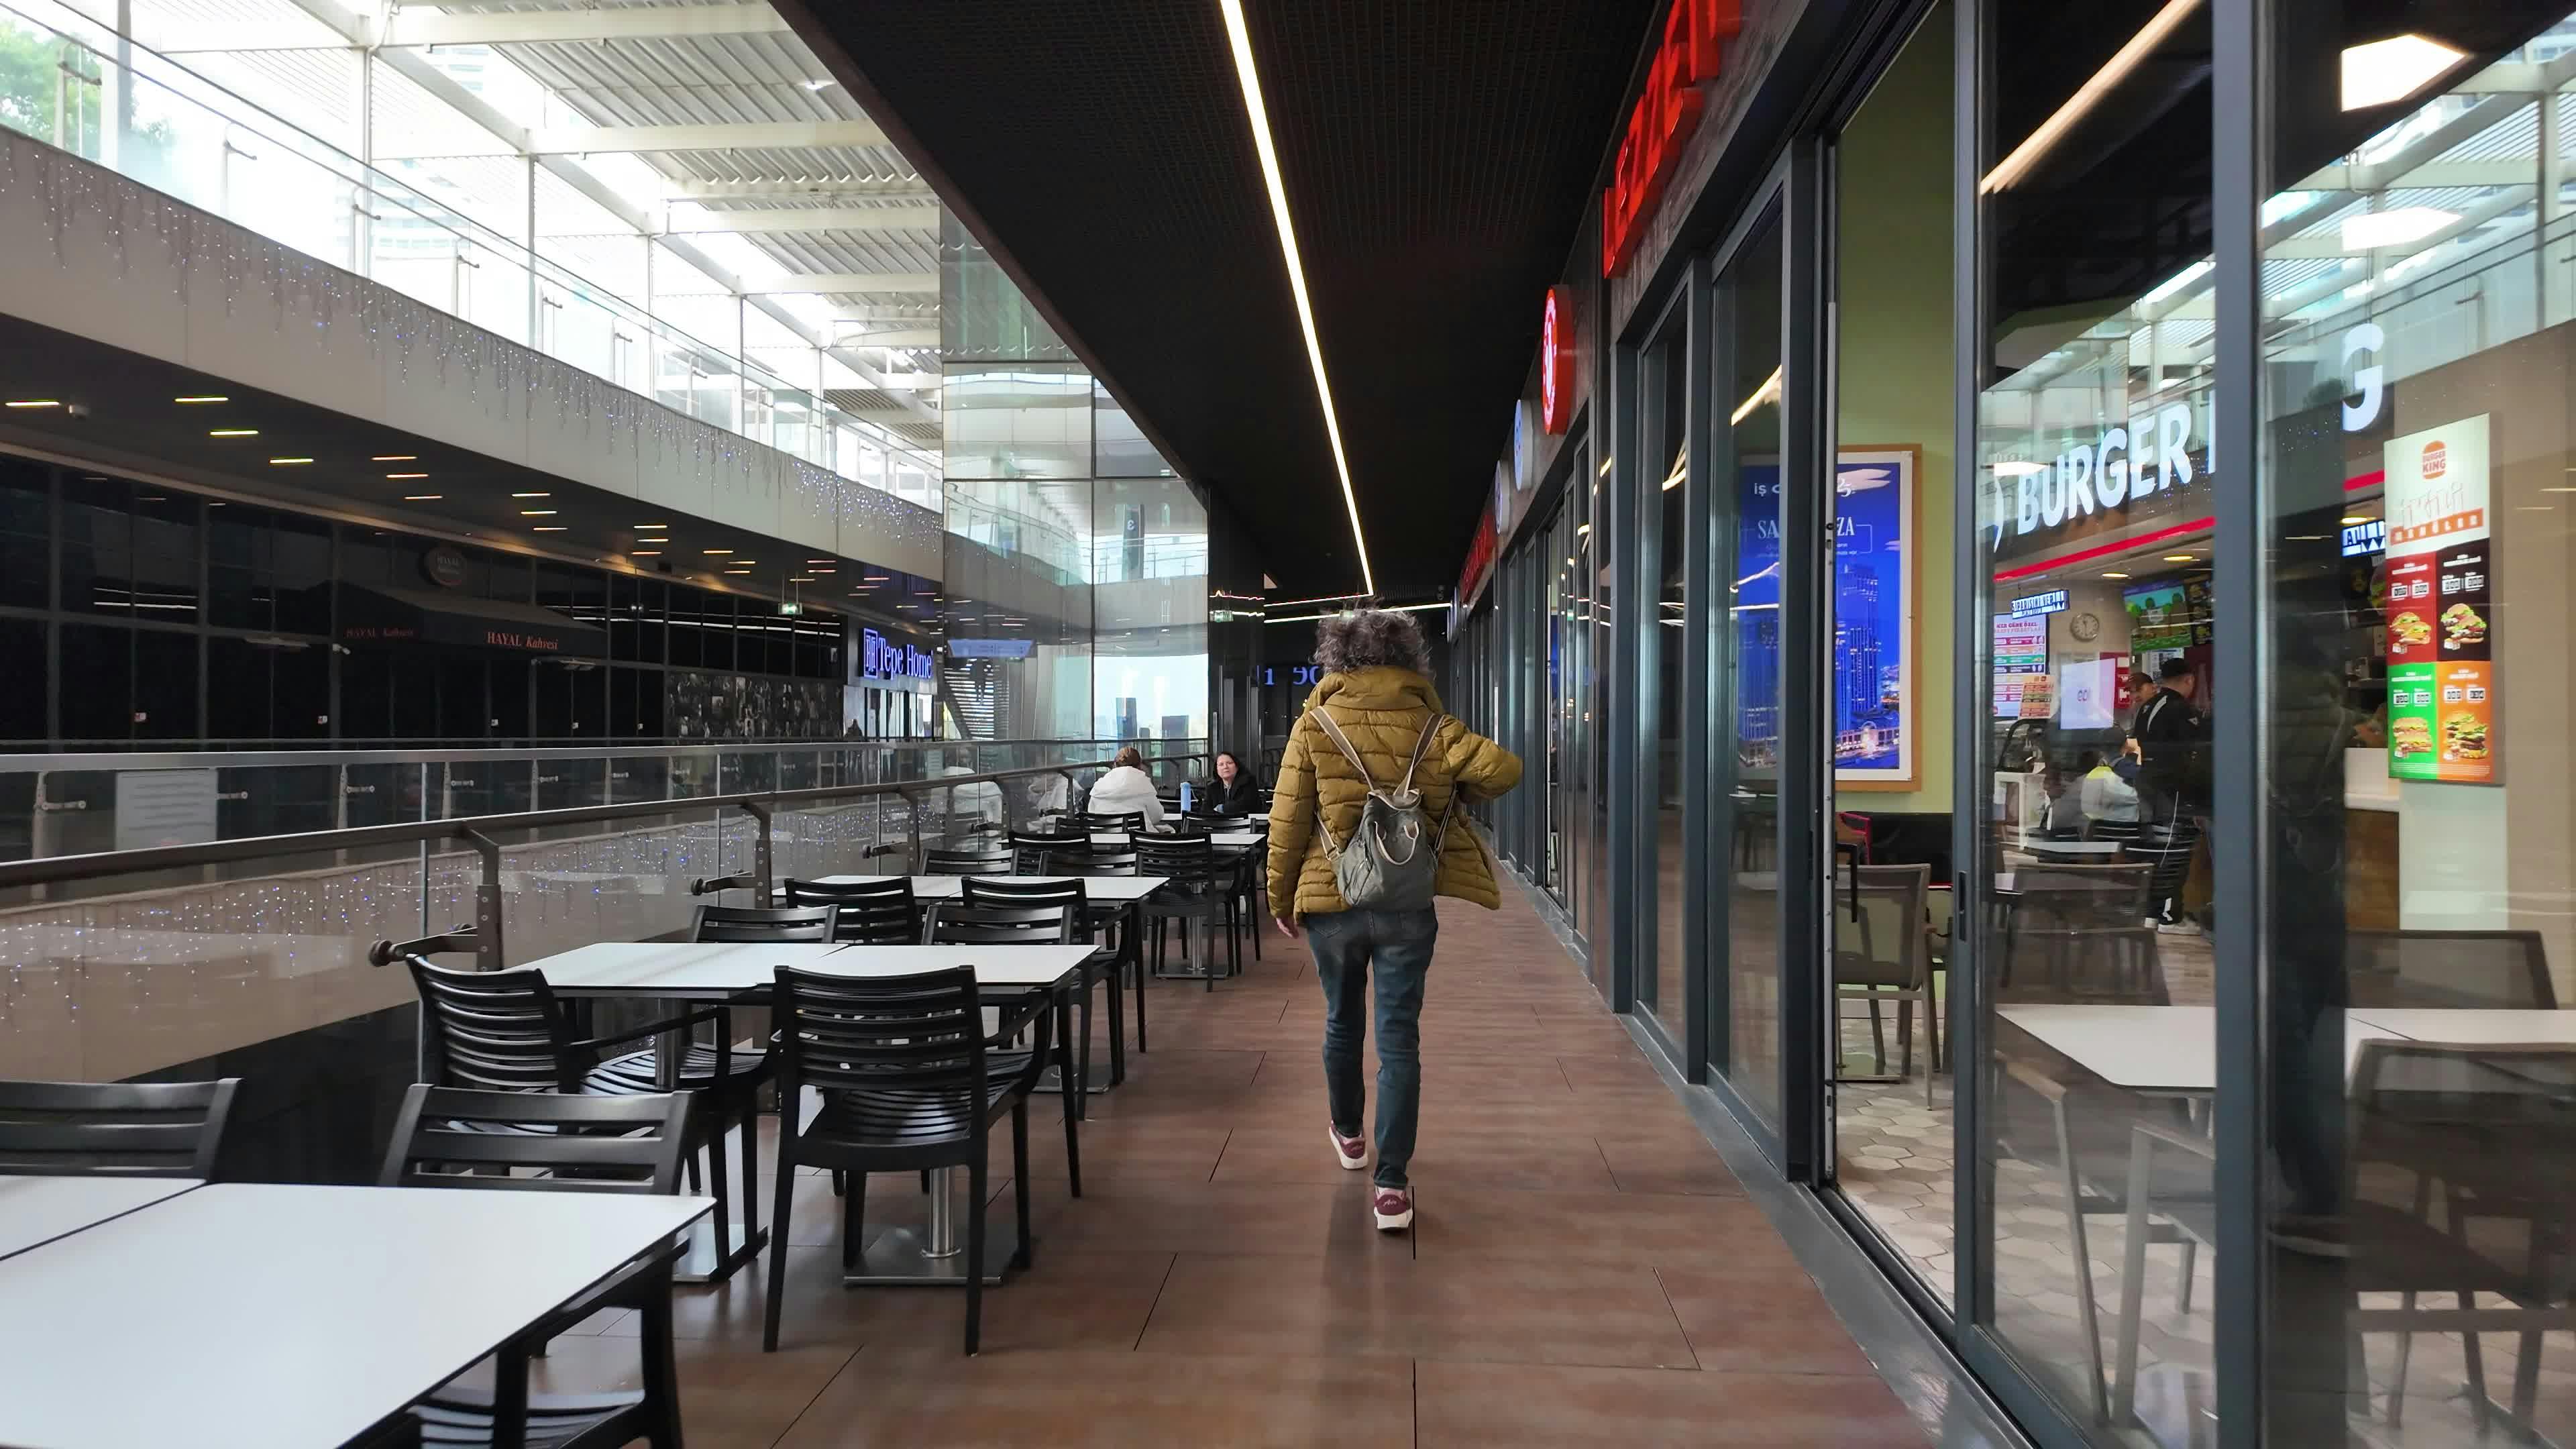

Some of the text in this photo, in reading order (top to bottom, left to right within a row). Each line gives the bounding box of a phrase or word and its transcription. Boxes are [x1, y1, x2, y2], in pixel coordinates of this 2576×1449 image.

[2017, 403, 2193, 535] BURGER
[2422, 458, 2446, 473] KING
[488, 632, 559, 650] HAYAL Kahvesi
[878, 637, 904, 680] Tepe
[906, 644, 933, 679] Home
